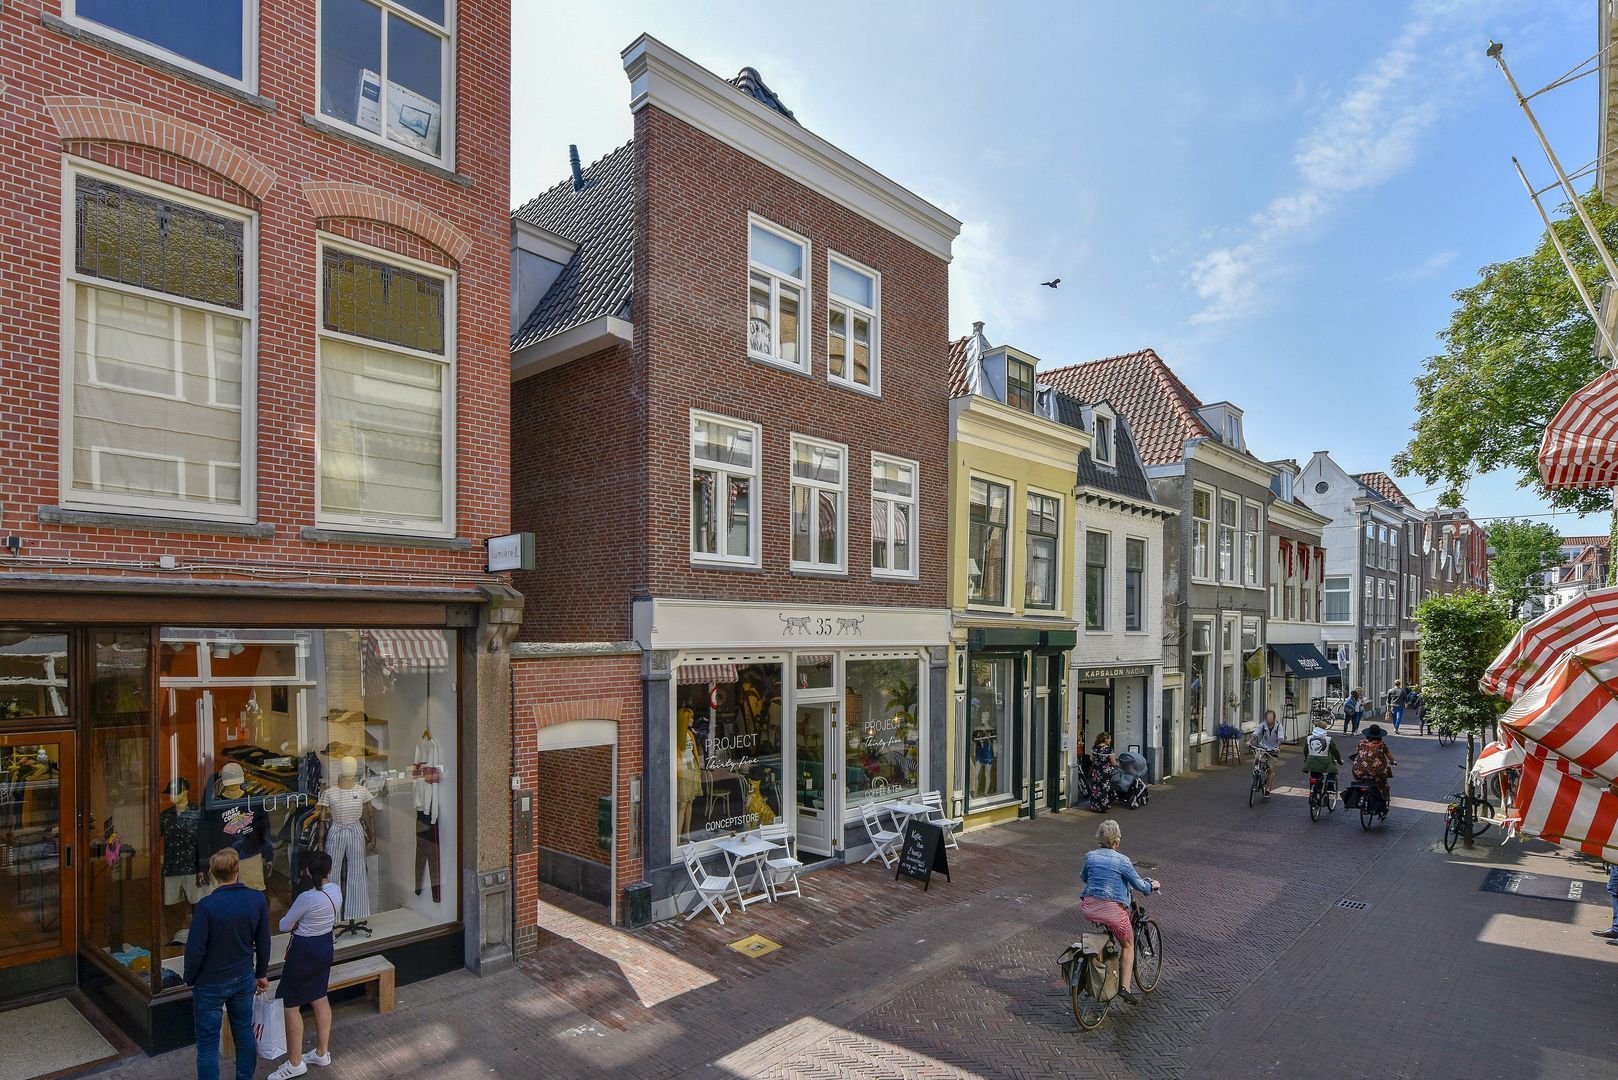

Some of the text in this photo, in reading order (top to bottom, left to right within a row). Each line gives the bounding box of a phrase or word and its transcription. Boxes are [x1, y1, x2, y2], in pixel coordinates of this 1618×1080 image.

[816, 617, 832, 636] 35
[1085, 667, 1146, 678] KAPSALON NADIA
[864, 717, 903, 732] PROJECT
[705, 733, 758, 752] PROJECT
[864, 784, 903, 799] COFFEE & TEA
[221, 806, 239, 819] FIRST
[705, 812, 759, 831] CONCEPTSTORE
